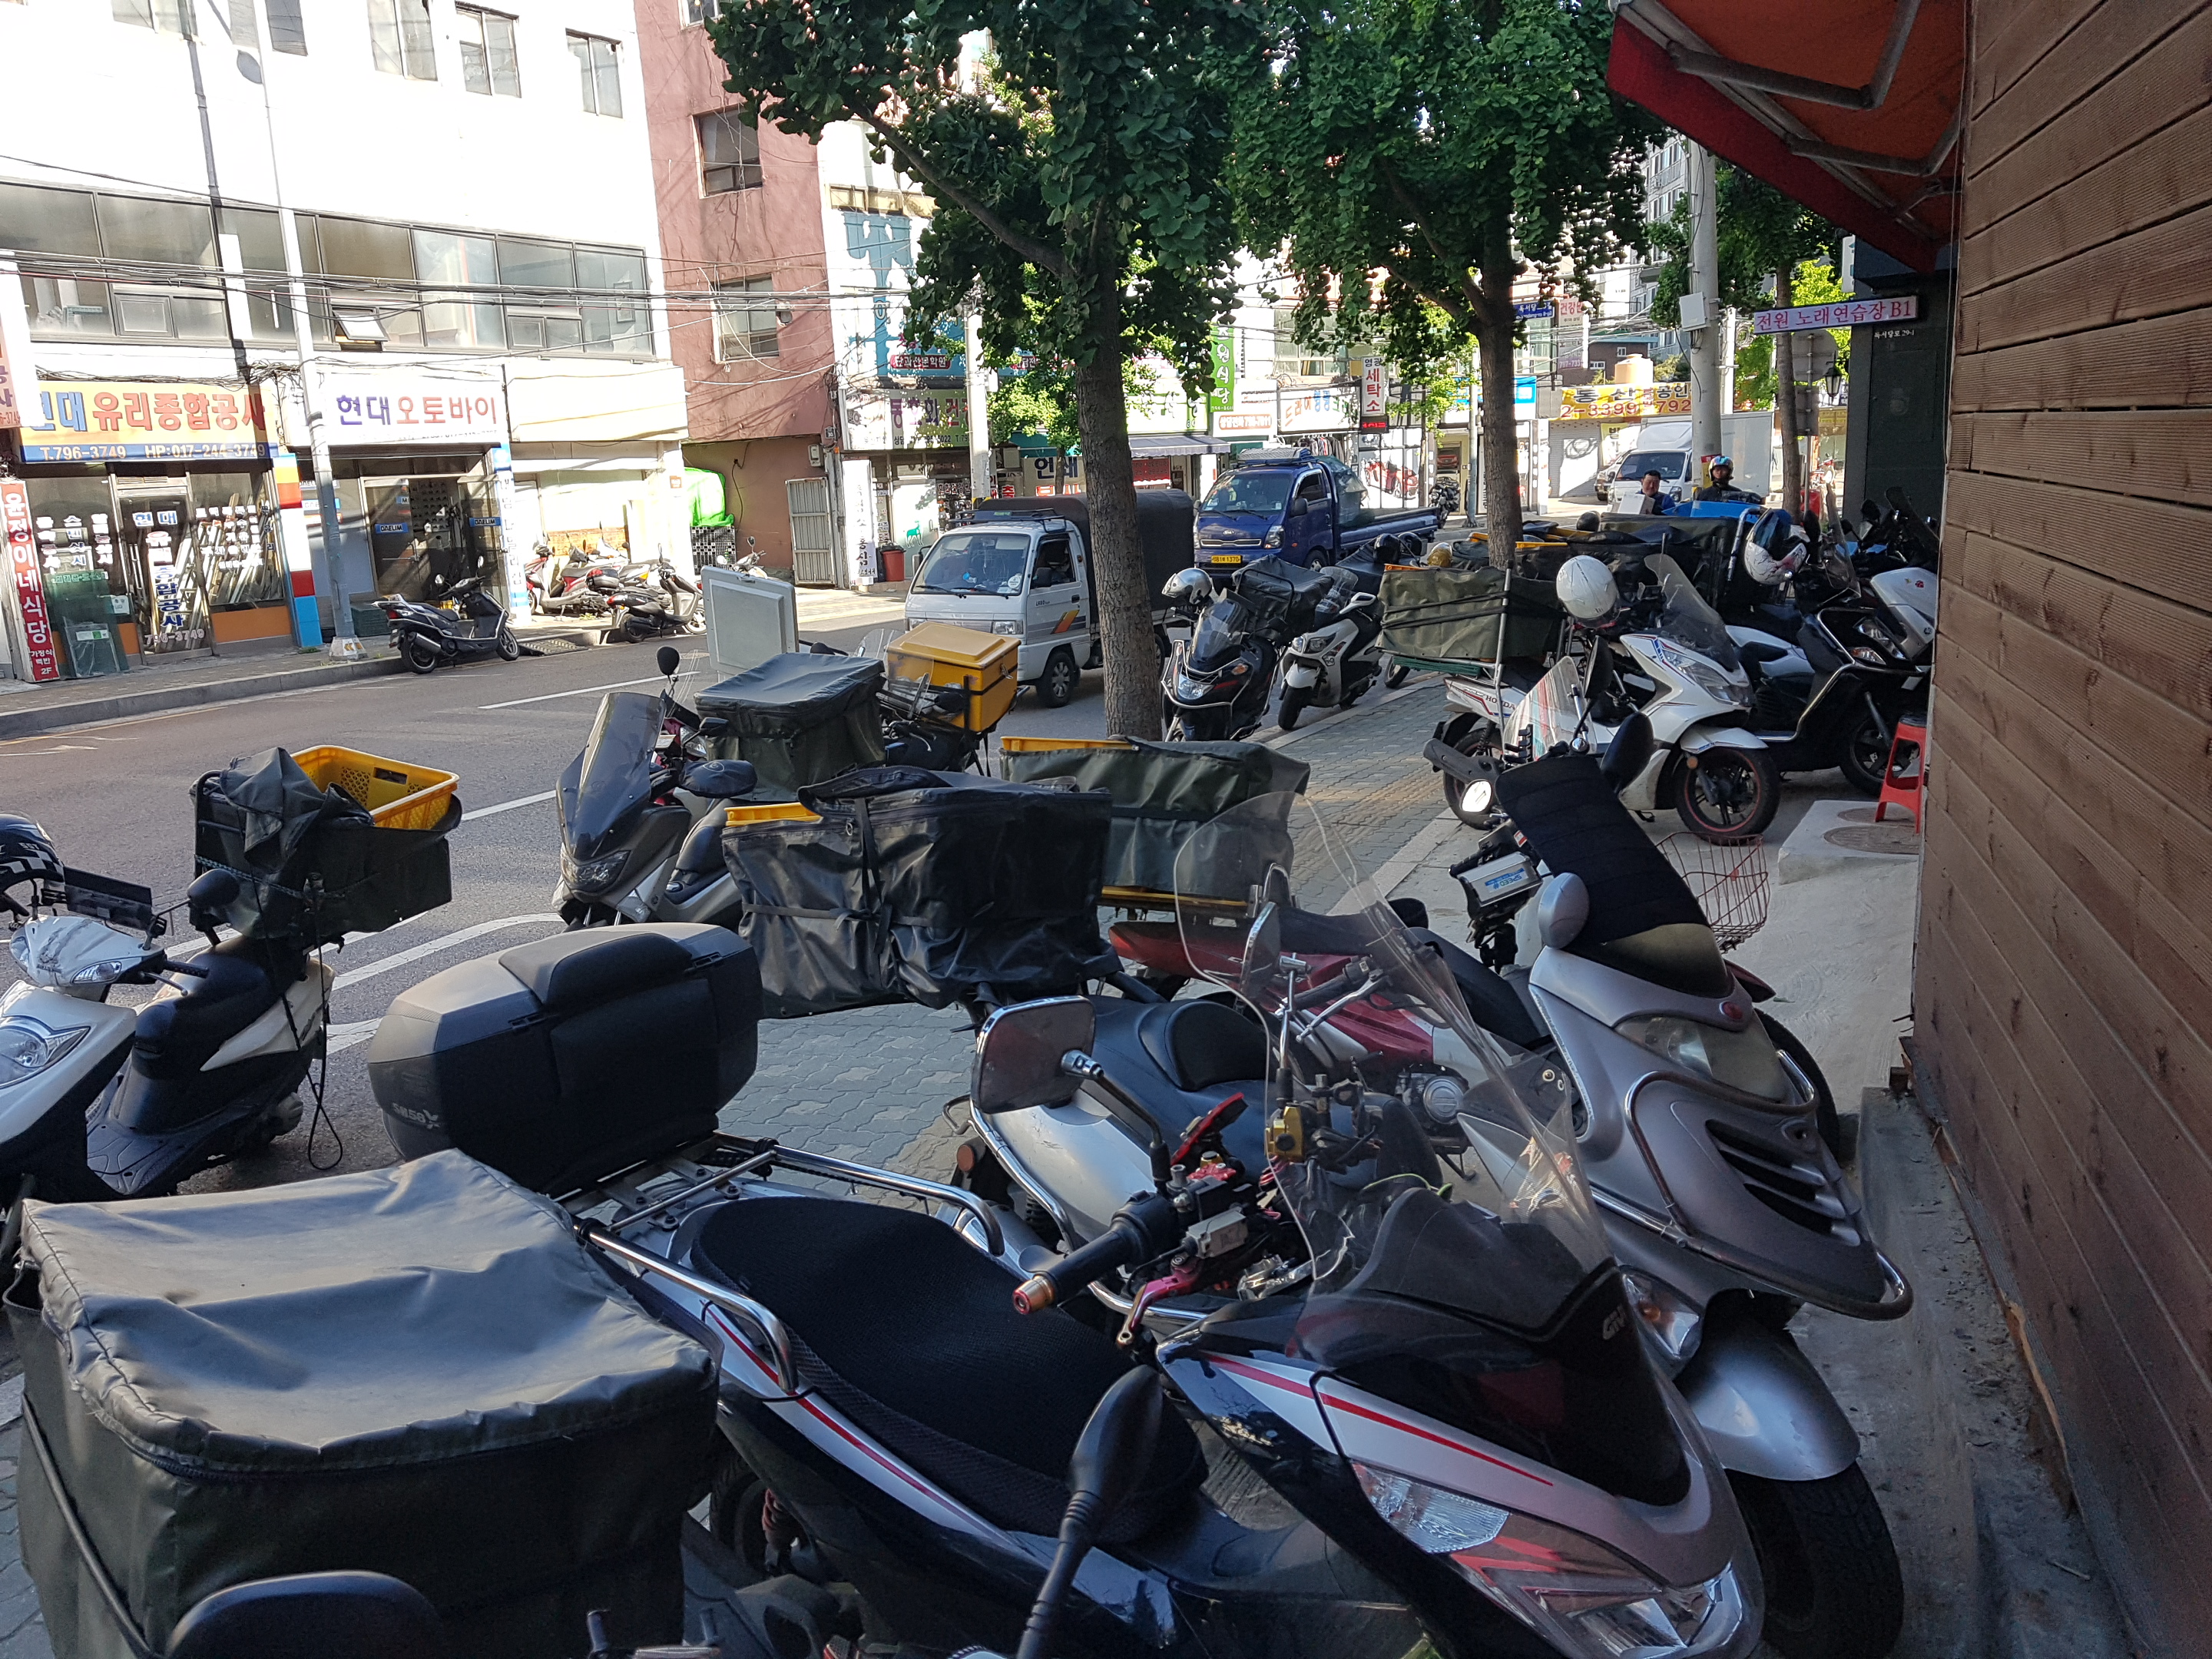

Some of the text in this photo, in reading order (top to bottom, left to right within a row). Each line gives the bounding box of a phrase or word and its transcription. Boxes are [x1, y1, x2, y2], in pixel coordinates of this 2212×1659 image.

[1757, 312, 1788, 331] 전원
[1890, 300, 1912, 318] B1
[1364, 358, 1382, 367] 영광
[1366, 368, 1382, 412] 세탁소
[93, 392, 267, 431] 유리종합공사
[336, 395, 496, 425] 현대 오토바이
[40, 445, 126, 461] T.796-3749
[132, 510, 177, 527] 현대
[5, 492, 46, 644] 윤정이네식당
[1485, 695, 1515, 710] HODA
